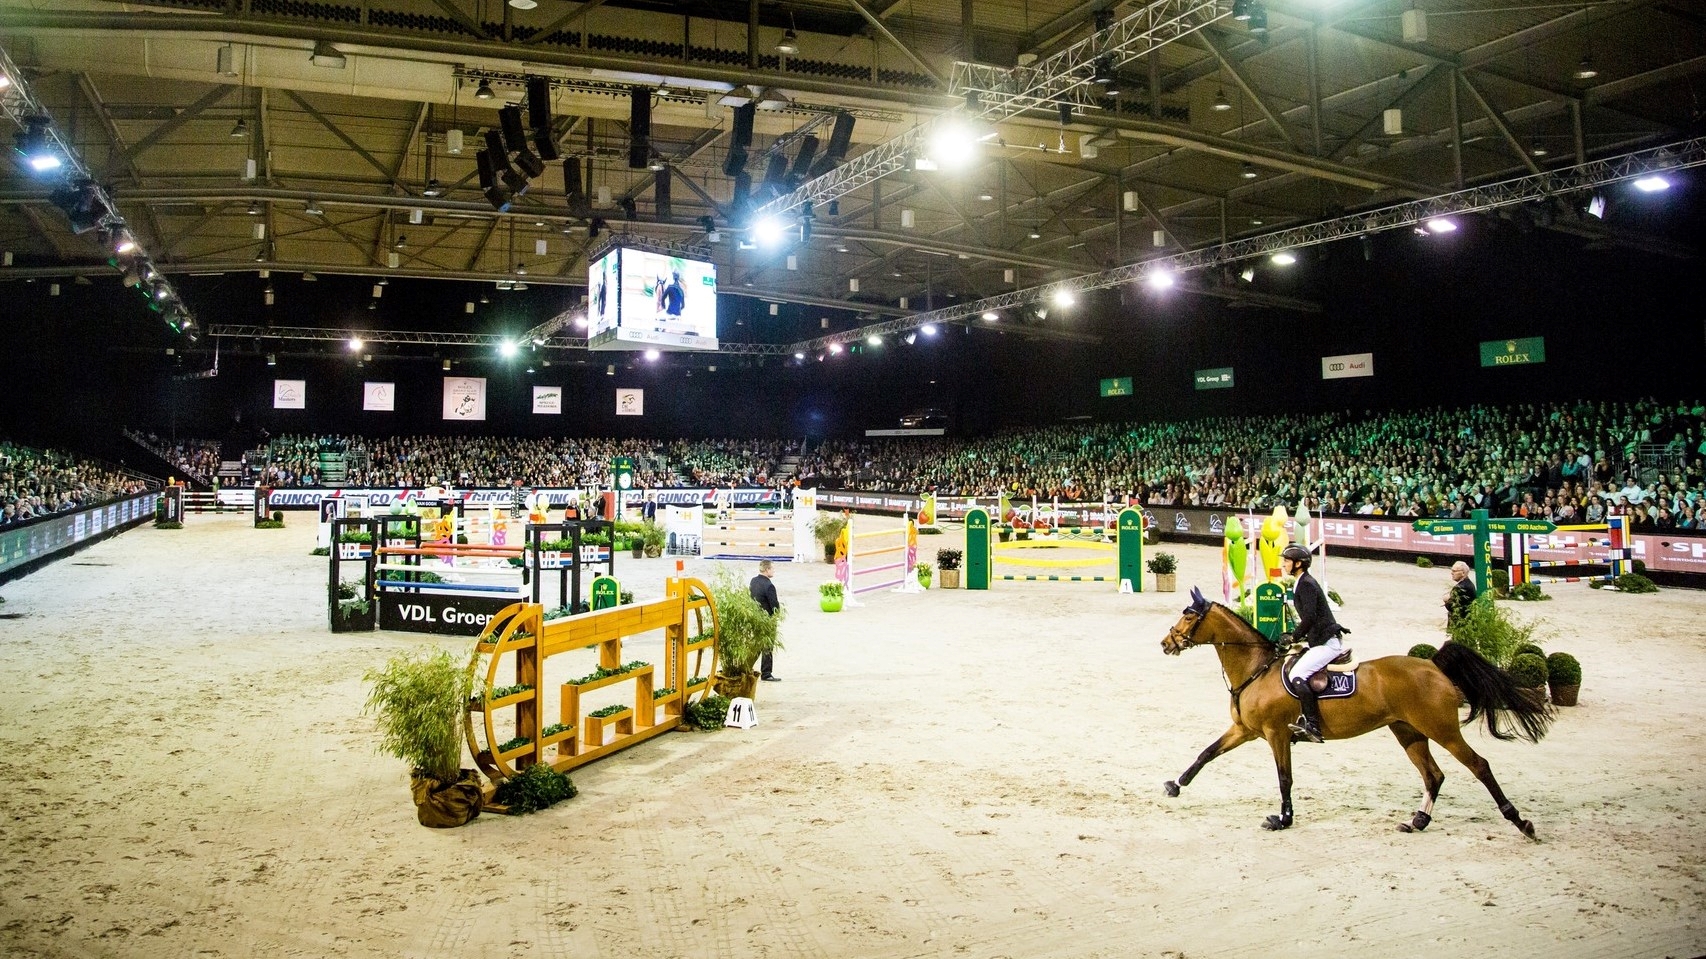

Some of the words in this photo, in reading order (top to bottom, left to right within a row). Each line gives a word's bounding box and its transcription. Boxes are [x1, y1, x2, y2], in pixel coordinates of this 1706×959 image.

[1349, 362, 1366, 370] Audi
[1495, 353, 1529, 365] ROLEX
[1107, 388, 1125, 396] ROLEX
[271, 493, 322, 505] GUNCO
[657, 493, 700, 504] GUNCO
[1325, 523, 1355, 536] SH
[1370, 525, 1403, 539] SH
[338, 542, 363, 559] VDL
[579, 545, 602, 562] VDL
[538, 550, 564, 569] VDL
[1483, 541, 1494, 601] GRAND
[398, 604, 436, 622] VDL
[732, 703, 742, 723] 11
